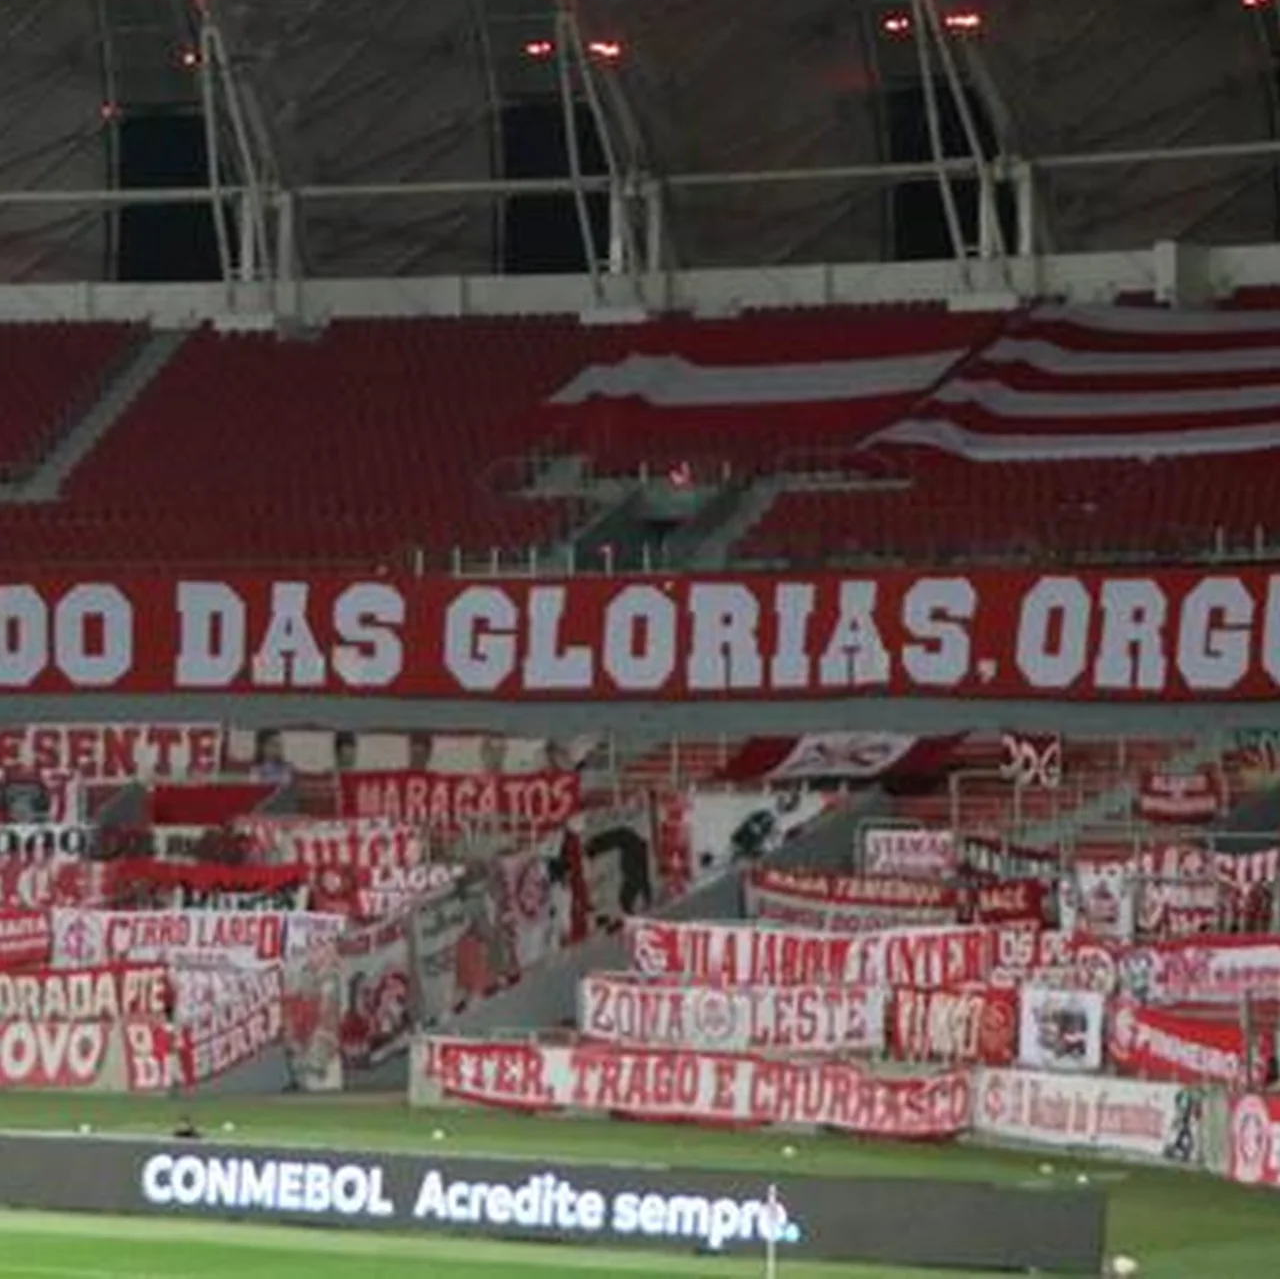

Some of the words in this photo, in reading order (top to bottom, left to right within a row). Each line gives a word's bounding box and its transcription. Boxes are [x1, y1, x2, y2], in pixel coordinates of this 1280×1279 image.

[174, 581, 405, 688] DAS
[591, 980, 684, 1040] ZONA
[747, 984, 868, 1044] LESTE
[572, 1053, 699, 1105] TRAGO
[713, 1060, 736, 1109] E
[142, 1153, 393, 1216] CONMEBOL
[414, 1169, 604, 1229] Acredite
[613, 1191, 801, 1247] sempre.
